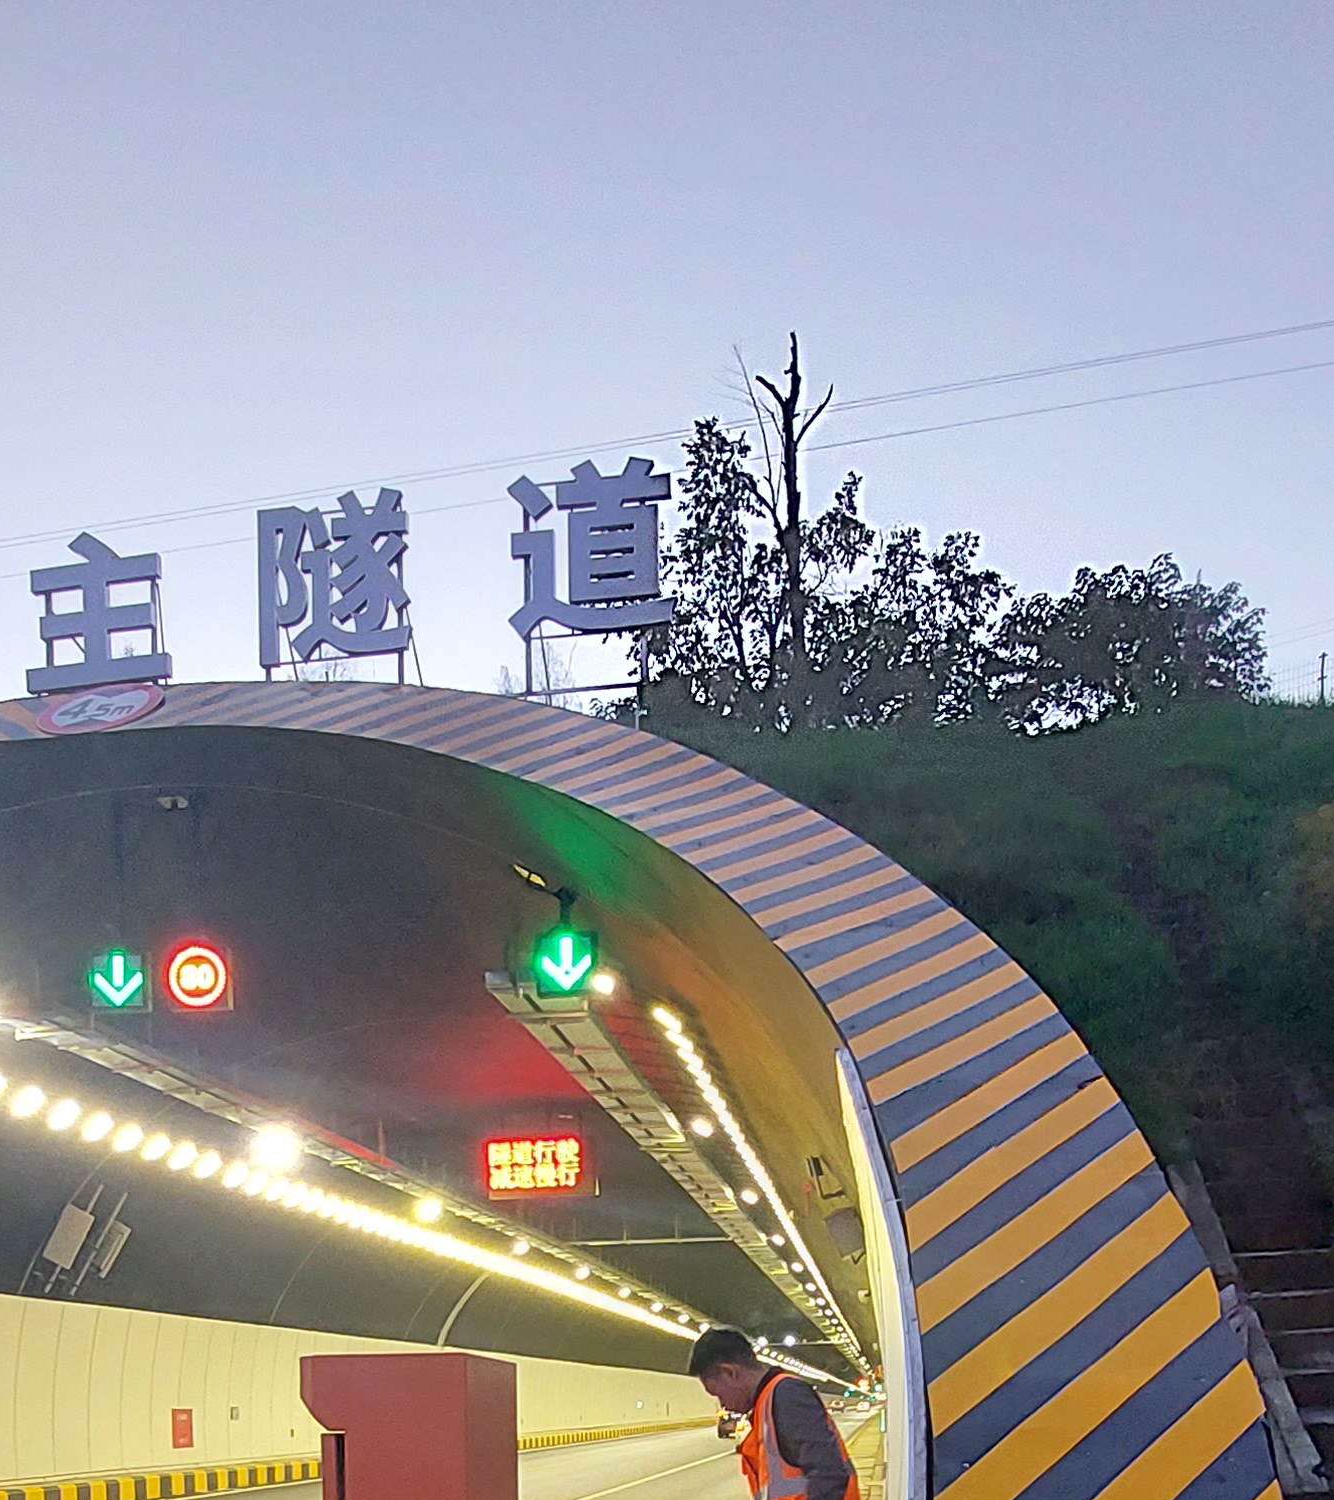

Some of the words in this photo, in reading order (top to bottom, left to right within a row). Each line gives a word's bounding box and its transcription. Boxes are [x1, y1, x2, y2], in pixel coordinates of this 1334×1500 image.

[179, 963, 217, 990] 80
[489, 1163, 581, 1190] 减速慢行
